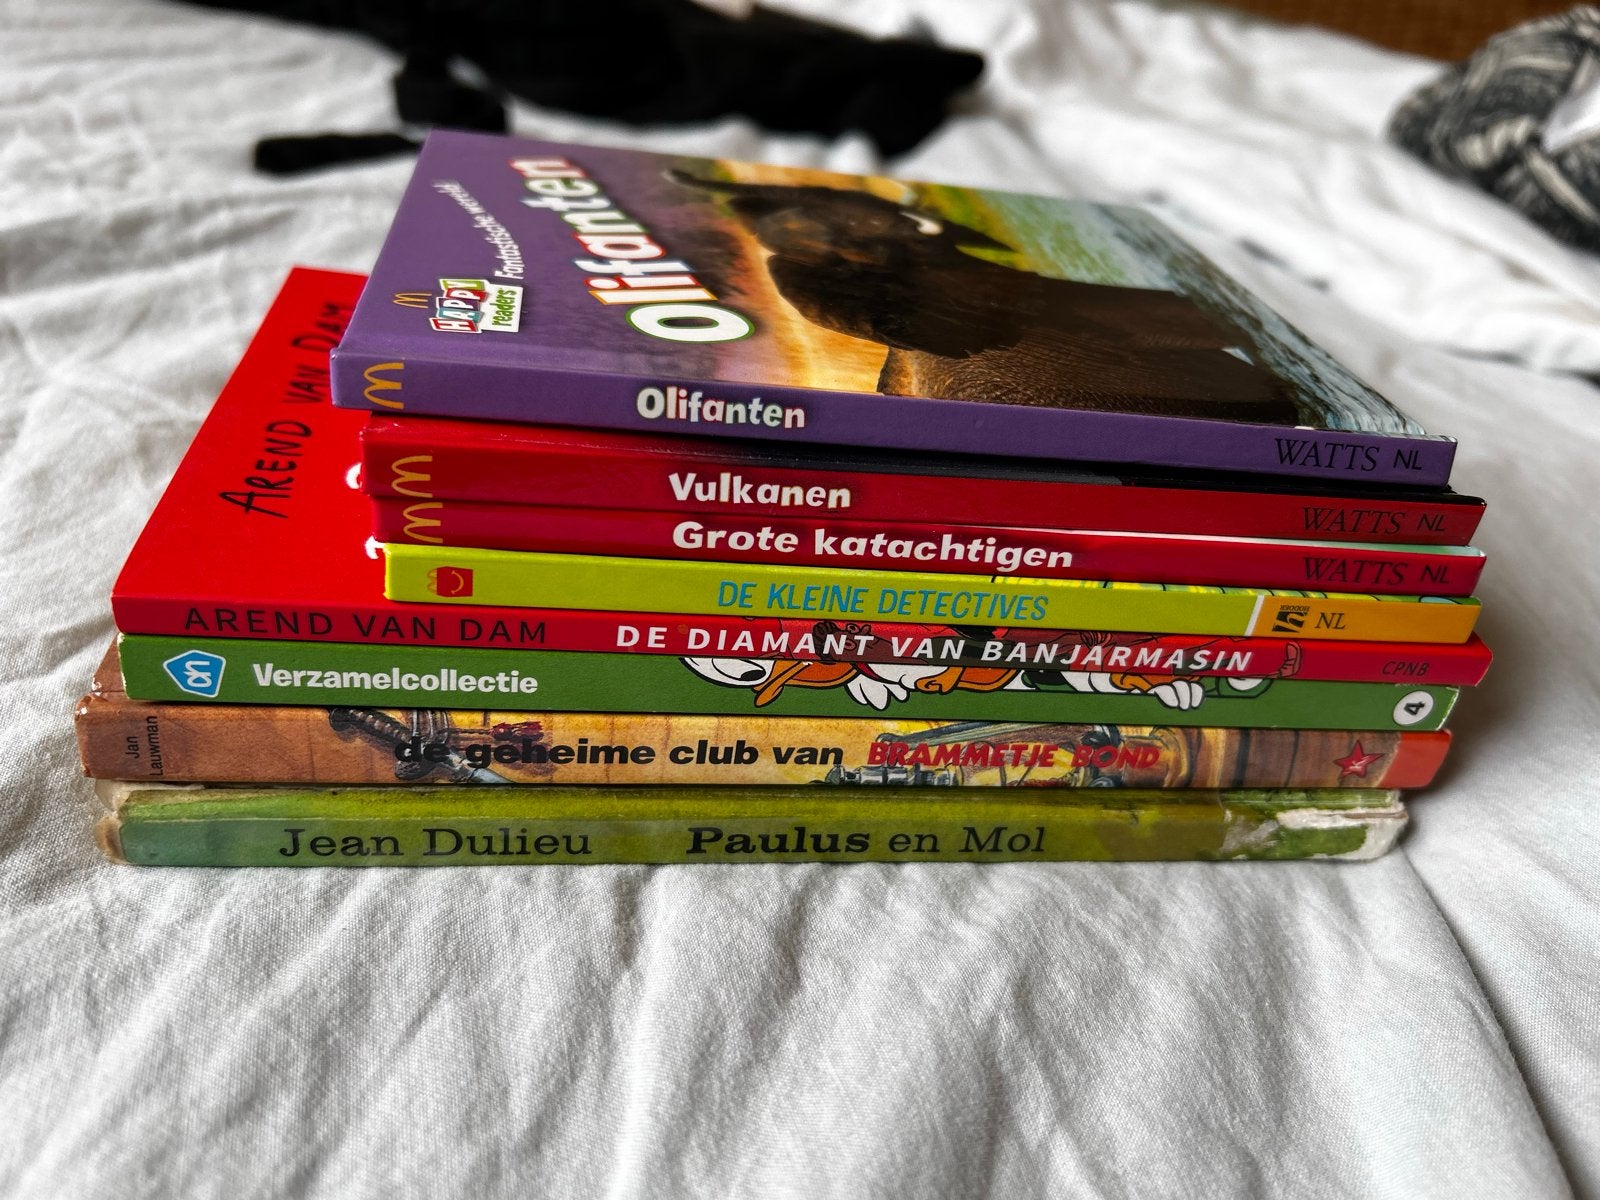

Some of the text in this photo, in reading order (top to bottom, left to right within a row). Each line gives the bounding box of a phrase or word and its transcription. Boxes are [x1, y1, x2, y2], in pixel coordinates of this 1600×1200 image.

[474, 215, 525, 279] Fantastische
[509, 157, 756, 343] Olifanten
[432, 280, 486, 332] HAPPY
[490, 287, 517, 327] readers
[637, 387, 805, 429] Olifanten
[219, 420, 313, 519] AREND
[1275, 438, 1423, 472] WATTS NL
[668, 472, 852, 509] Vulkanen
[1303, 507, 1446, 535] WATTS NL
[672, 521, 1073, 573] Grote katachtigen
[1304, 557, 1450, 585] WATTS NL
[717, 581, 1049, 621] DE KLEINE DETECTIVES
[184, 607, 546, 645] AREND VAN DAM
[1314, 612, 1346, 630] NL
[616, 625, 1253, 672] DE DIAMANT VAN BANJARMASIN
[252, 663, 539, 694] Verzamelcollectie
[1381, 660, 1430, 677] CPNB
[1403, 701, 1425, 716] 4
[125, 736, 140, 759] Jan
[146, 715, 163, 776] Lauwman
[396, 733, 1160, 769] de geheime club van BRAMMETJE BOND
[279, 827, 593, 857] Jean Dulieu
[686, 826, 1045, 854] Paulus en Mol
